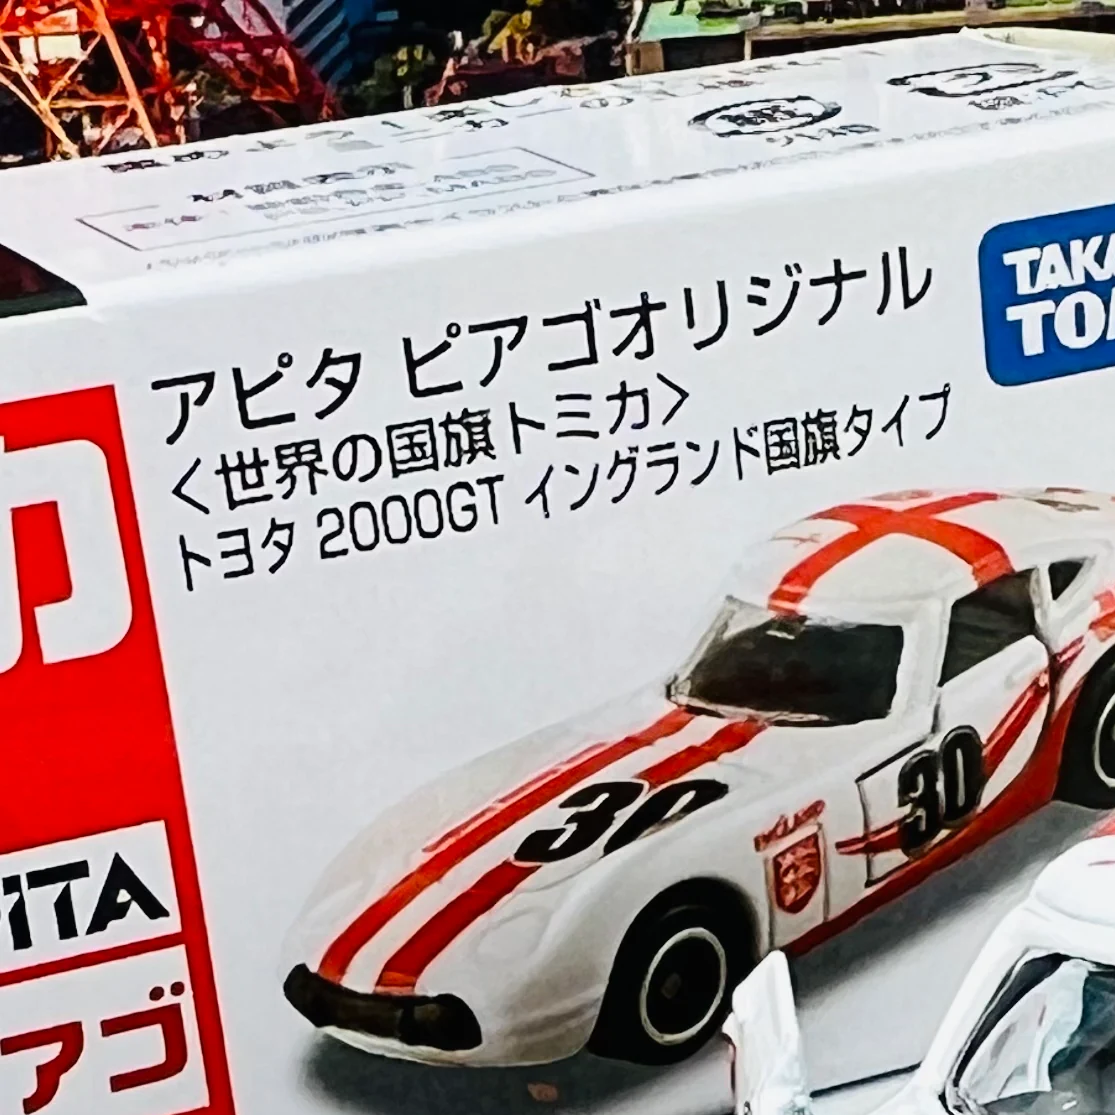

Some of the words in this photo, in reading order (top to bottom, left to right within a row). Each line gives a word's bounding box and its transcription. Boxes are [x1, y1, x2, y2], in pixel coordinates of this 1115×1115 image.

[152, 348, 363, 447] アピタ
[403, 247, 933, 399] ピアゴオリジナル
[179, 517, 296, 593] トヨタ
[317, 475, 505, 560] 2000GT
[525, 383, 953, 519] イングランド国旗タイプ
[897, 724, 985, 858] 30
[0, 852, 170, 951] ITA
